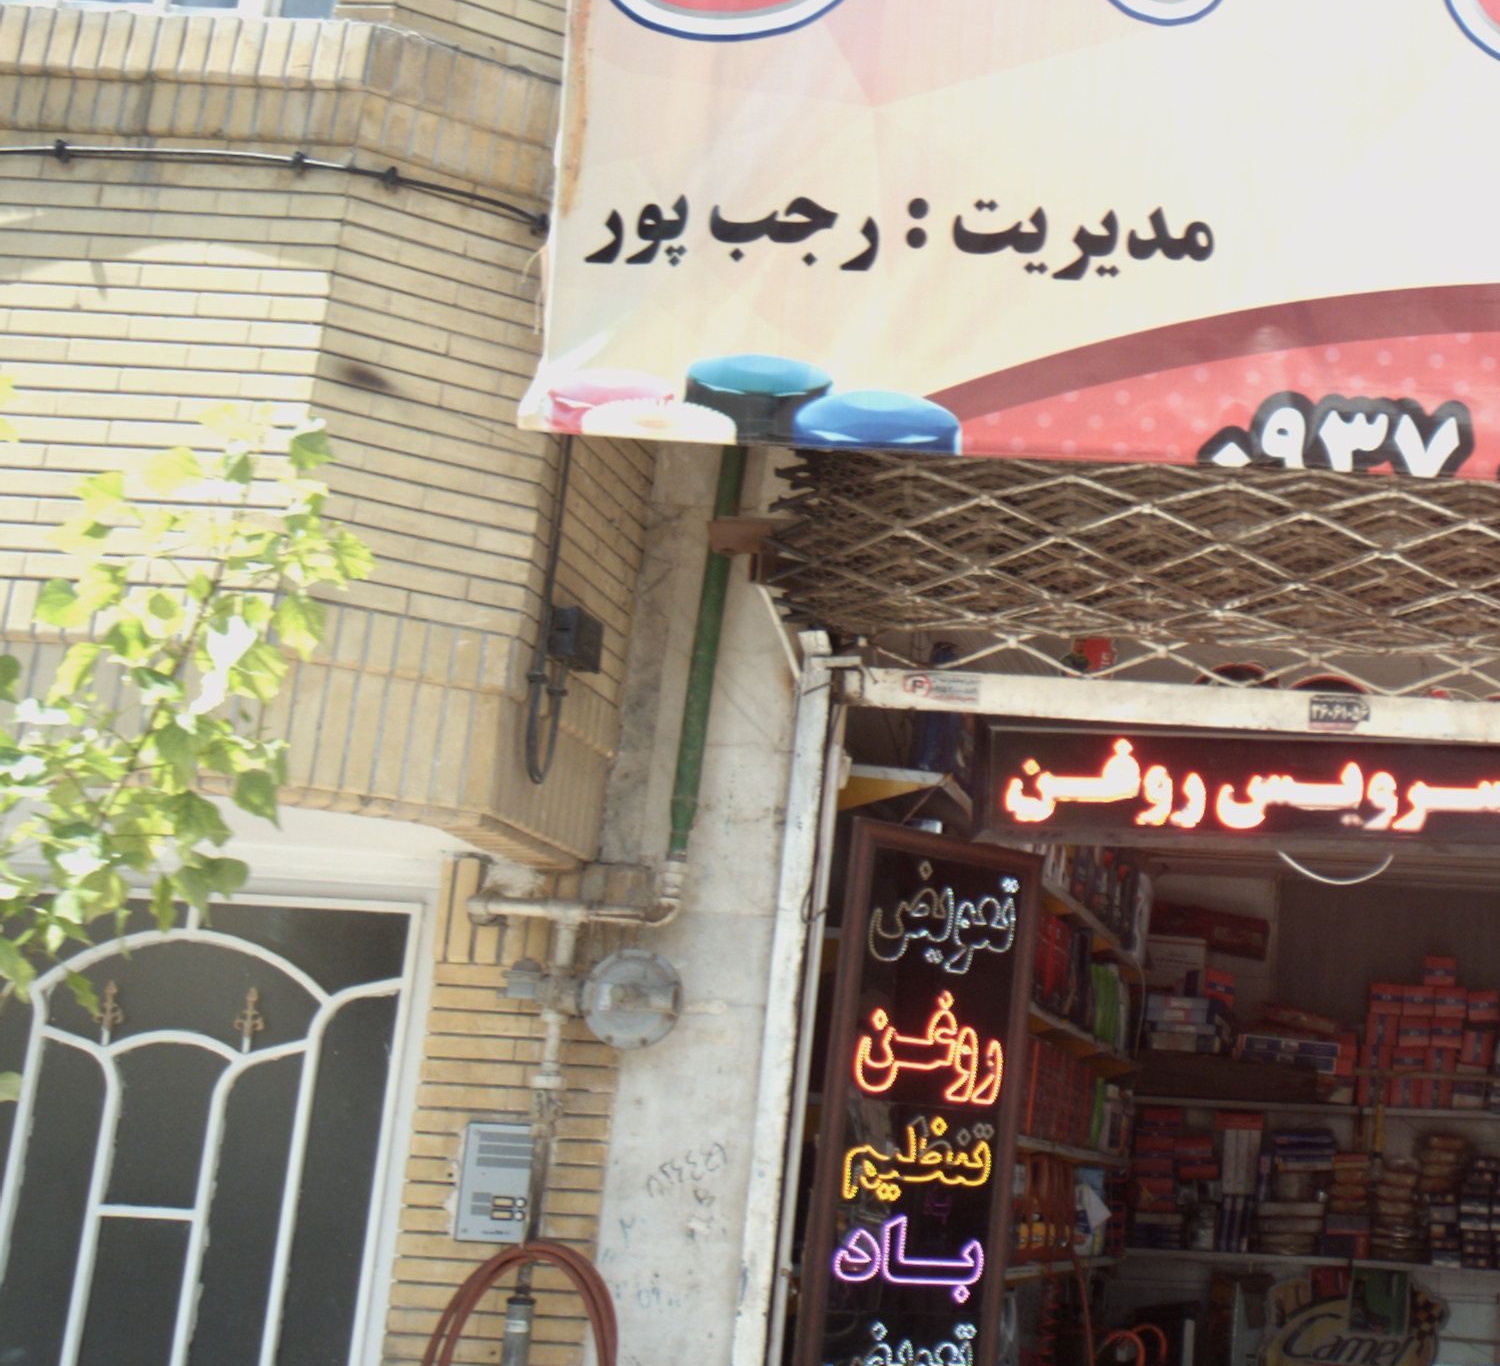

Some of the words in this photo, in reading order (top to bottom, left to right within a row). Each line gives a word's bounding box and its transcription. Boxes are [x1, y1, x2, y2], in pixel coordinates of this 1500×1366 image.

[582, 196, 689, 268] پور
[707, 196, 882, 272] رجب
[952, 201, 1215, 283] مدیریت
[1203, 399, 1468, 479] ۰۹۳۷
[1006, 738, 1206, 826] روغن
[868, 860, 1019, 975] تعویض
[855, 989, 1003, 1105] روغن
[842, 1115, 993, 1201] تنظیم
[832, 1214, 985, 1305] باد
